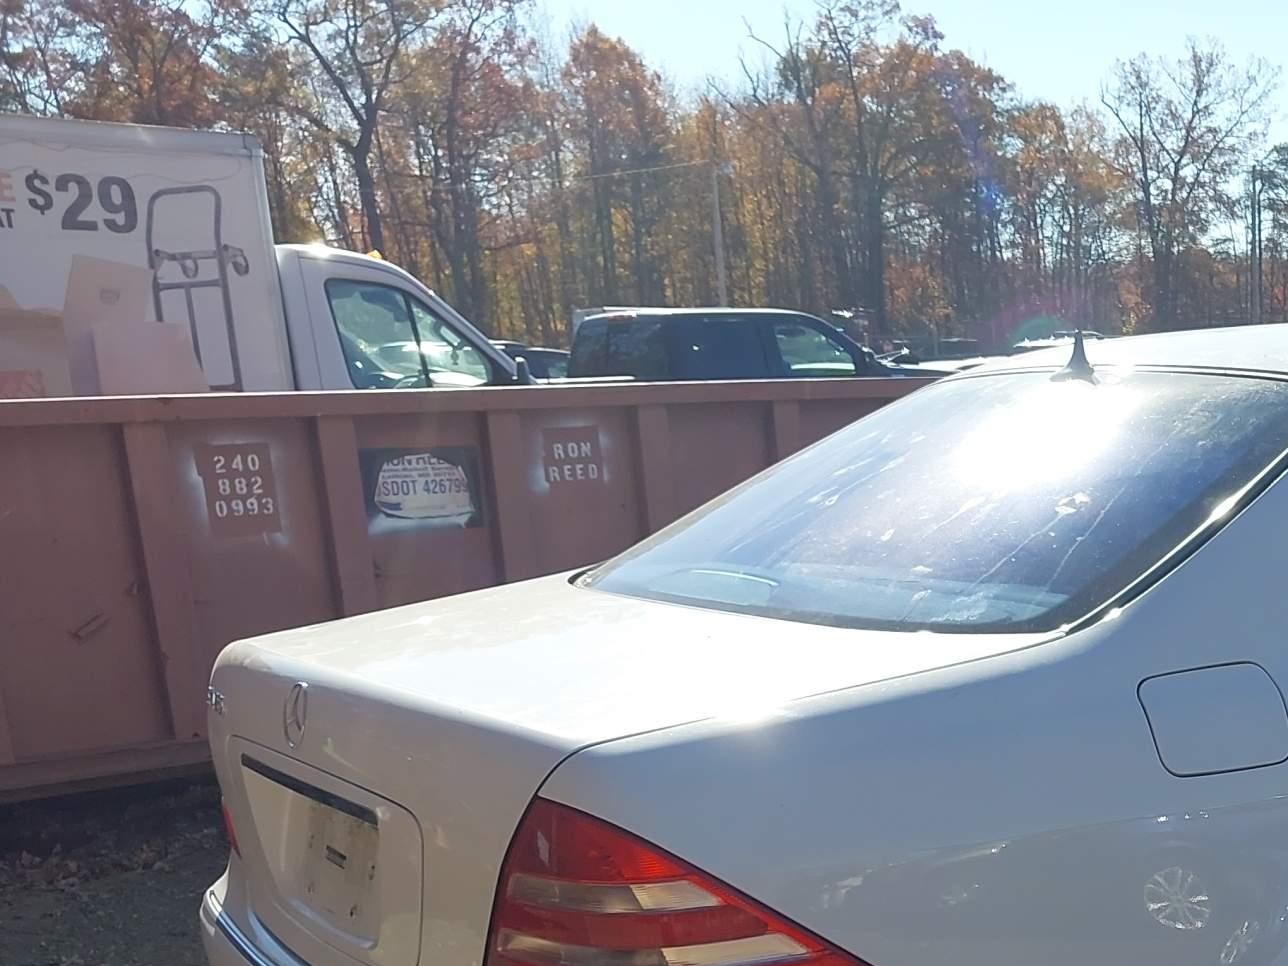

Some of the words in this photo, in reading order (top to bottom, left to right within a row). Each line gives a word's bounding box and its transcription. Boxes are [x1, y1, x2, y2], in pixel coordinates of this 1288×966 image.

[25, 169, 138, 234] $29
[552, 441, 591, 459] RON
[213, 454, 260, 474] 240
[548, 463, 598, 482] REED
[218, 476, 263, 495] 882
[215, 496, 274, 517] 0993
